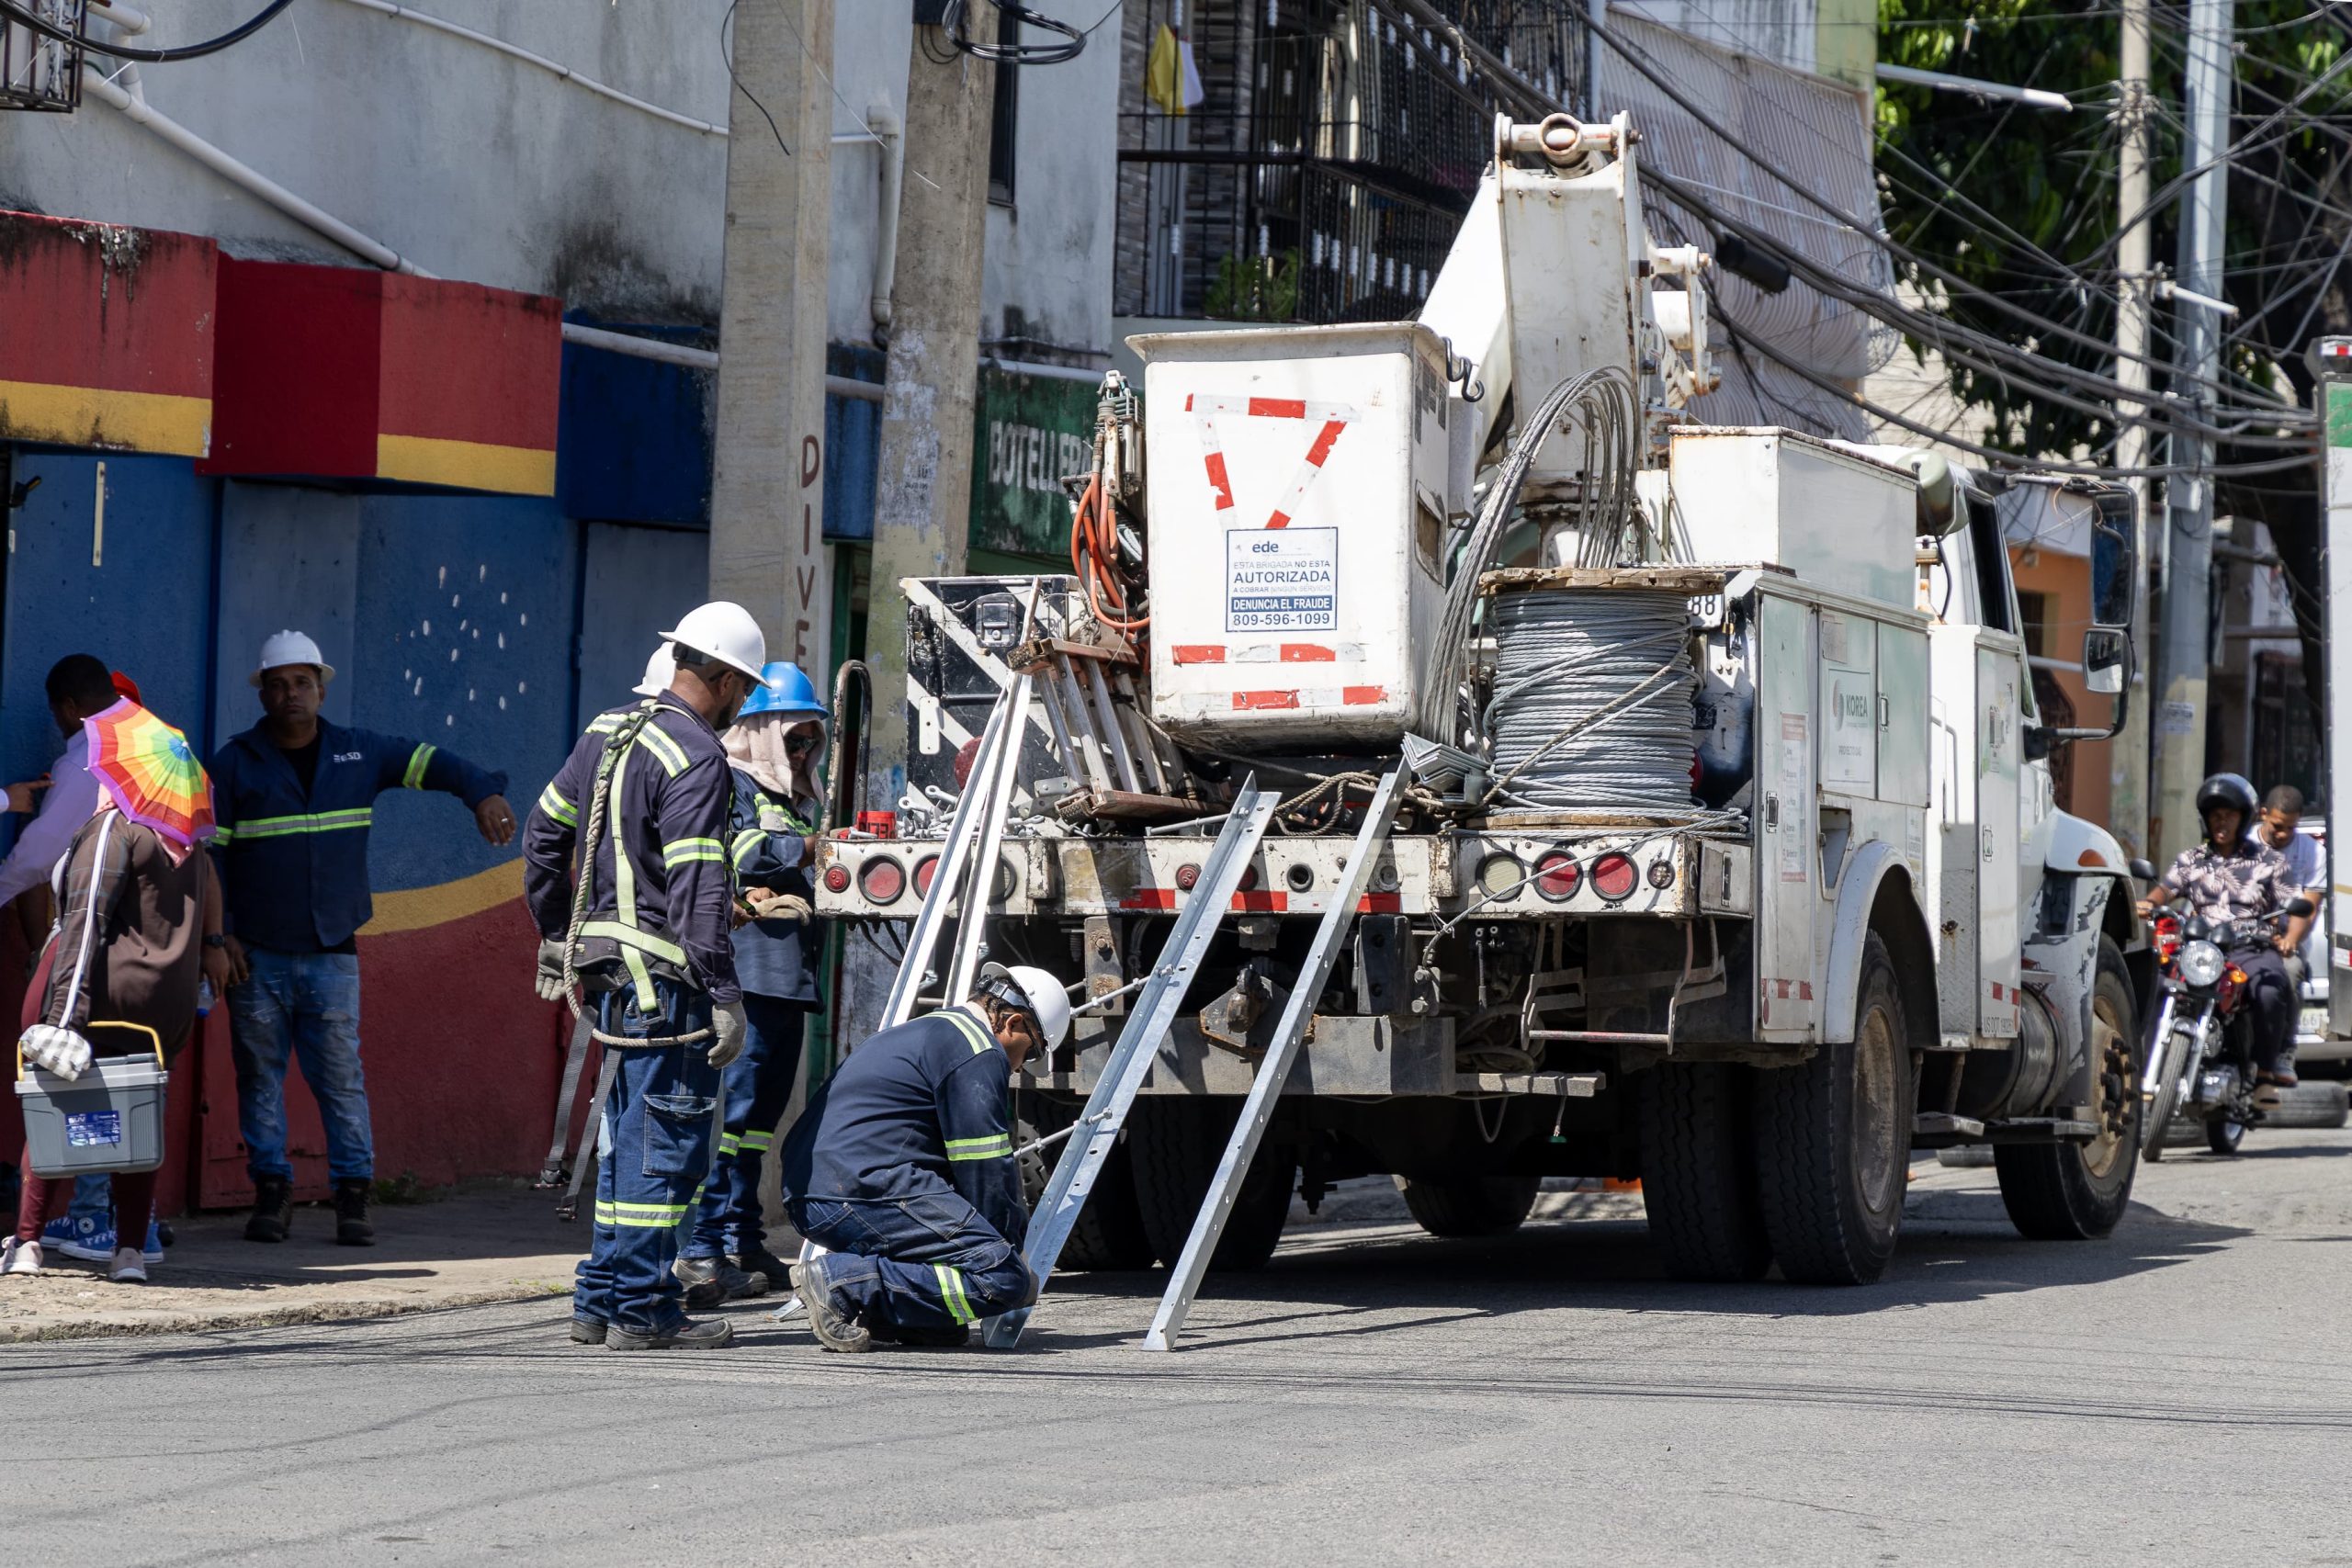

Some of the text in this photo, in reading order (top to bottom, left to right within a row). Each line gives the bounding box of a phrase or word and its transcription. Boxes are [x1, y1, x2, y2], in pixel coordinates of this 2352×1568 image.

[1252, 541, 1279, 553] ede
[1233, 561, 1254, 570] ESTA
[1256, 560, 1293, 569] BRIGADA
[1309, 559, 1330, 568] ESTA
[1234, 570, 1330, 583] AUTORIZADA
[1233, 597, 1330, 611] DENUNCIA EL FRAUDE
[1233, 613, 1330, 626] 809-596-1099
[1846, 694, 1868, 717] KOREA
